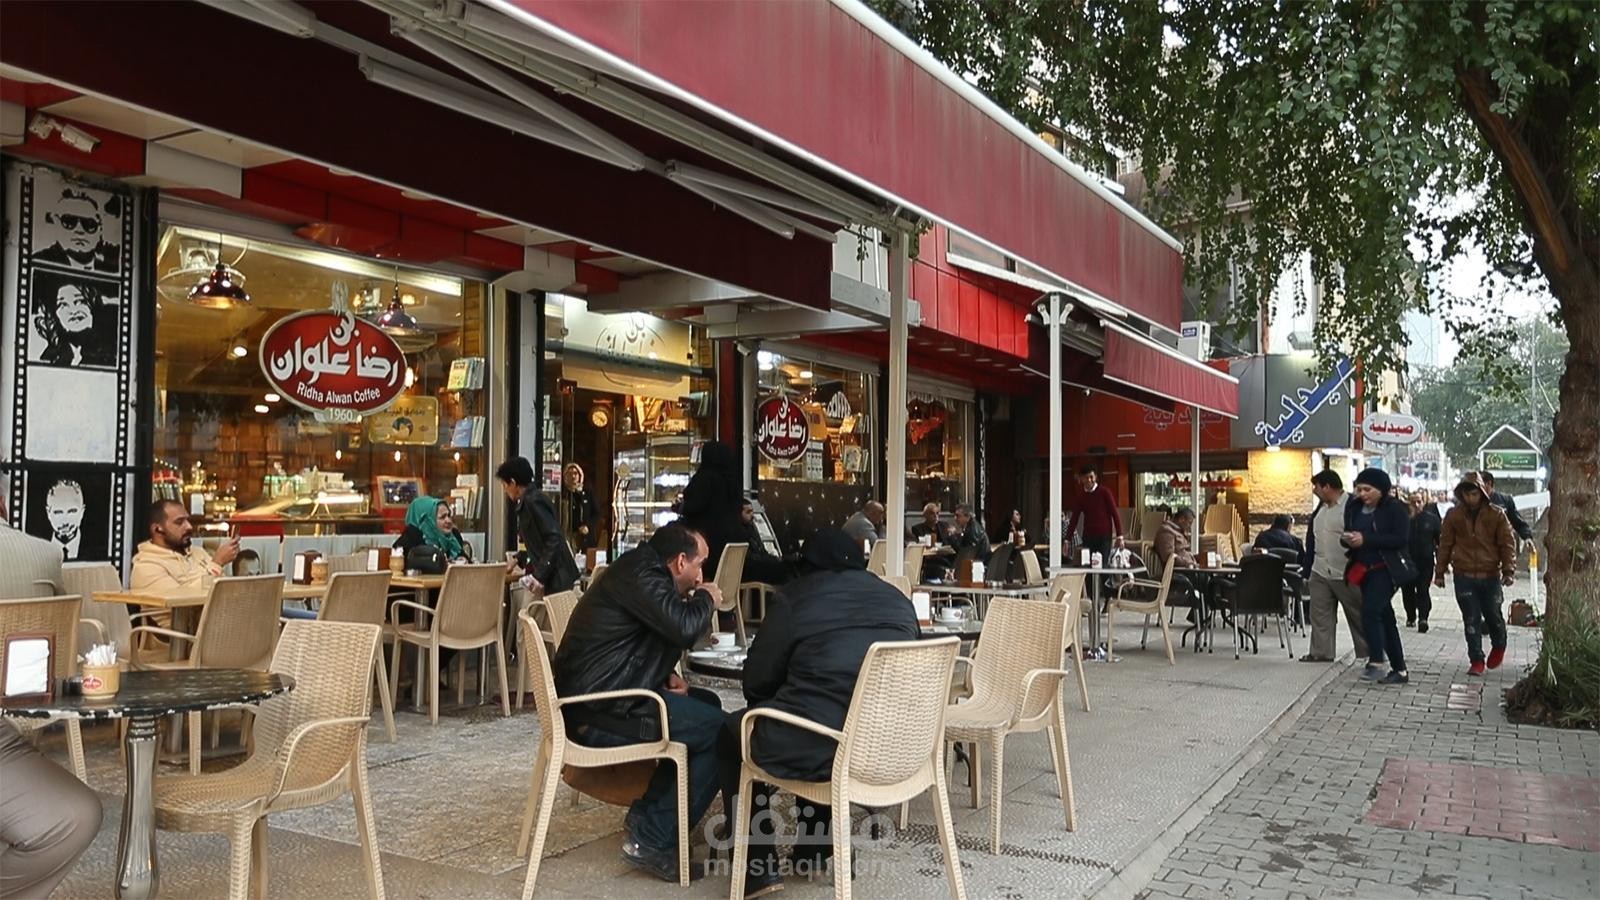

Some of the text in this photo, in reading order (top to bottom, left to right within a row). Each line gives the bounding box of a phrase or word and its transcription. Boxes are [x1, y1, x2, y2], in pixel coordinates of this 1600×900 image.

[329, 311, 361, 347] بن
[270, 335, 399, 387] رضا علوان
[296, 381, 381, 404] Ridha Alwan Coffee
[328, 408, 353, 421] 1960
[778, 395, 791, 419] بن
[758, 413, 806, 444] رضا علوان
[1369, 418, 1414, 437] صيدلية
